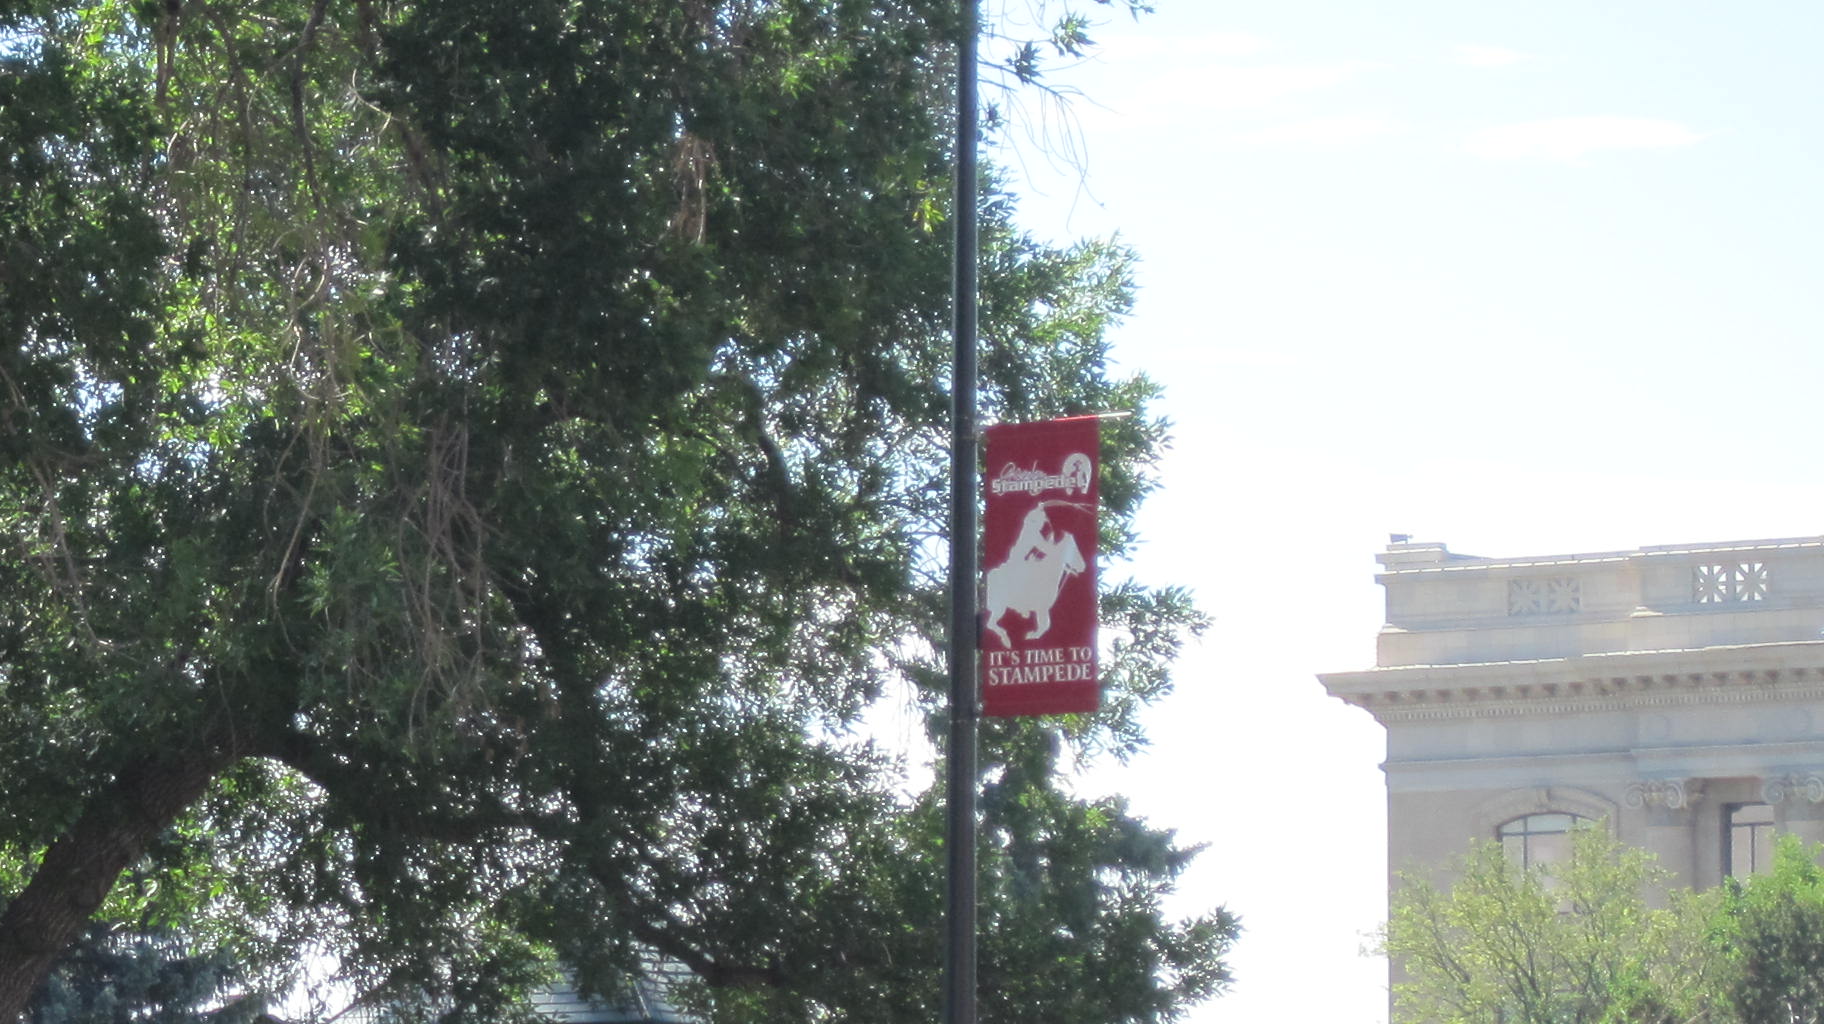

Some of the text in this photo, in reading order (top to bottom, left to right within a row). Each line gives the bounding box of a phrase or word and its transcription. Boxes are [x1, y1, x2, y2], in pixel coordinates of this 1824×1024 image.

[989, 647, 1092, 666] IT'S TIME TO
[988, 663, 1092, 686] STAMPEDE
